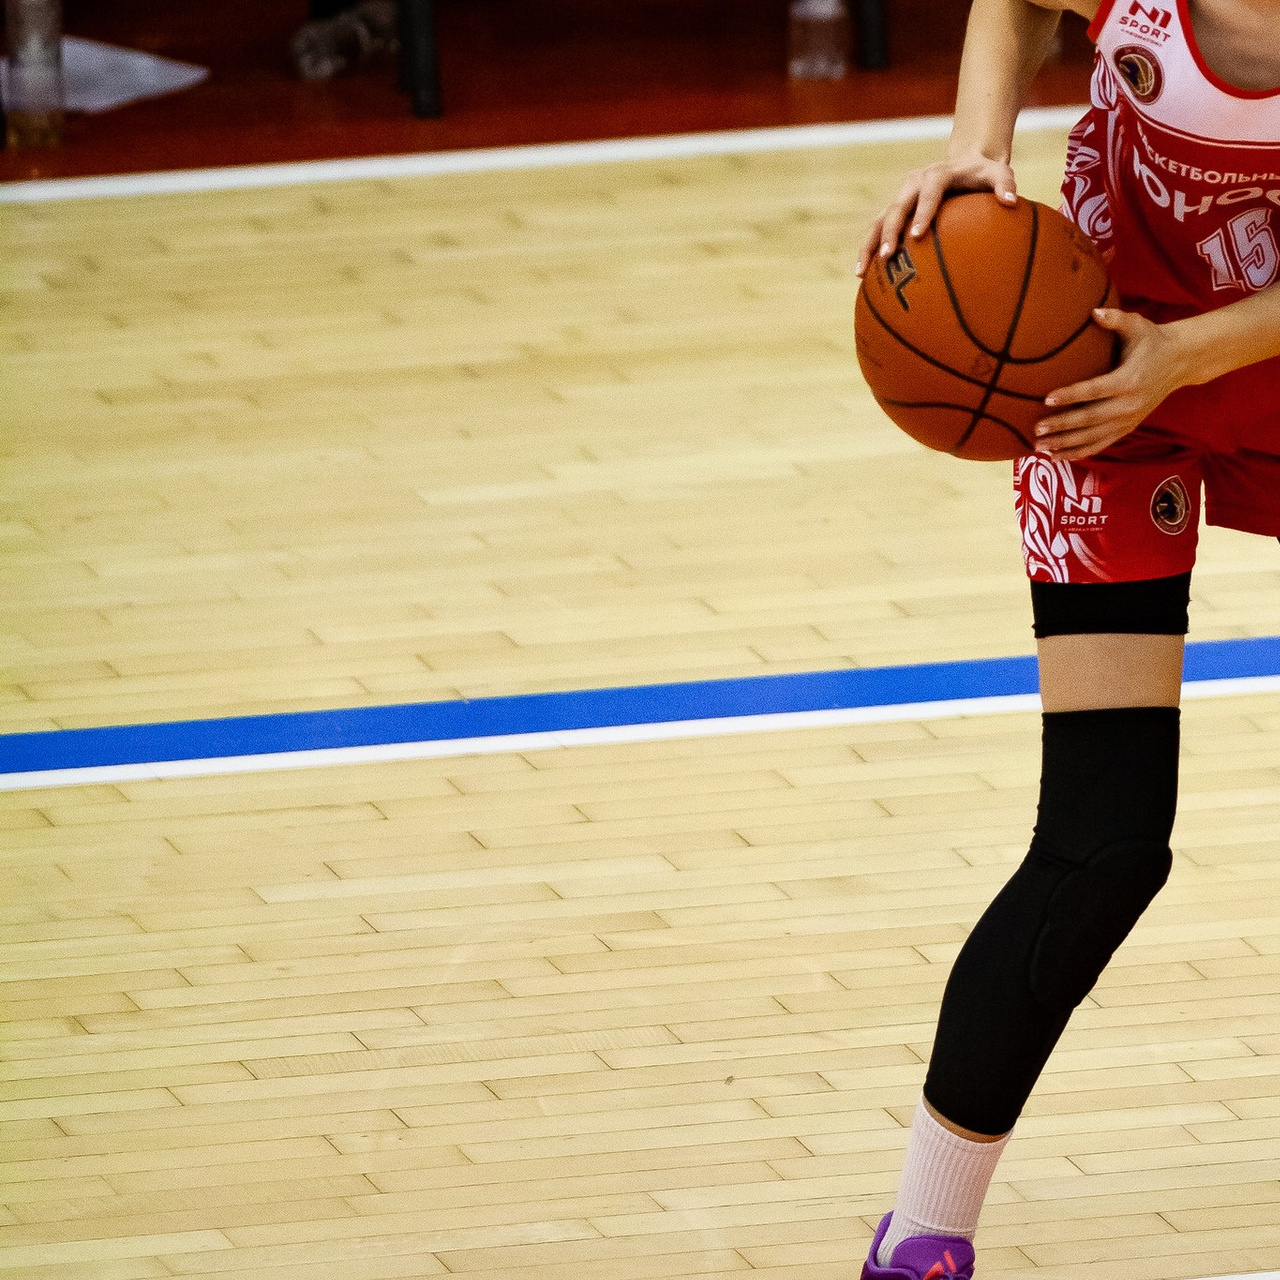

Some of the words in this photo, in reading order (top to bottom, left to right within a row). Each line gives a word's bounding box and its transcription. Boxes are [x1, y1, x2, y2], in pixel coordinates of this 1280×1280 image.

[1119, 16, 1171, 42] SPORT
[1196, 207, 1280, 292] 15
[1060, 515, 1108, 525] SPORT
